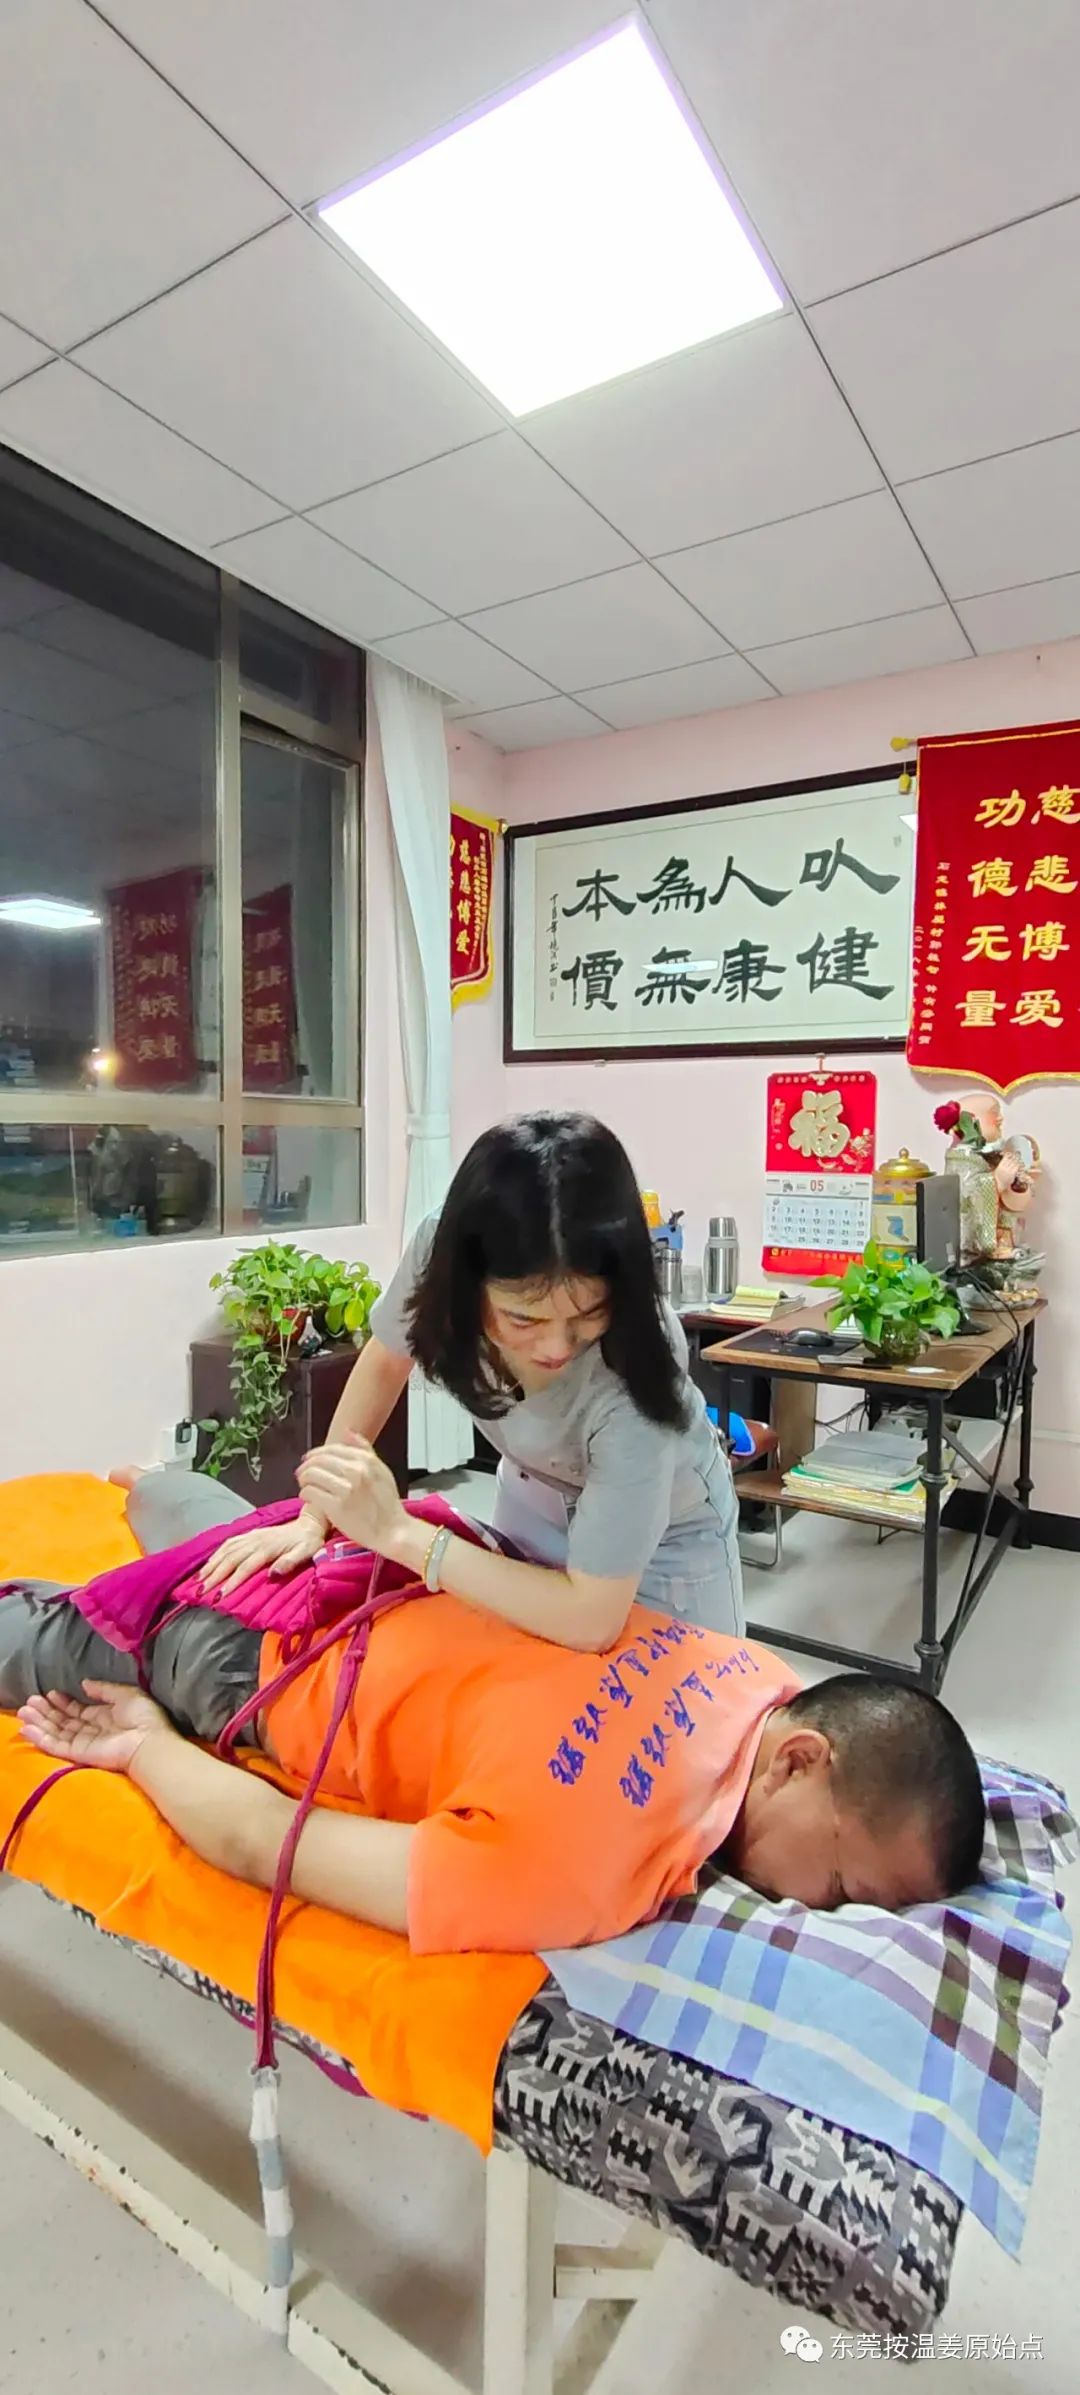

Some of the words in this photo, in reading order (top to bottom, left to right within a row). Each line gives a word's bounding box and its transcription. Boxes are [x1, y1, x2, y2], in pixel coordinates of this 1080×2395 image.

[955, 789, 1026, 1028] 功德无量
[788, 1089, 851, 1158] 福
[810, 1180, 824, 1192] 05
